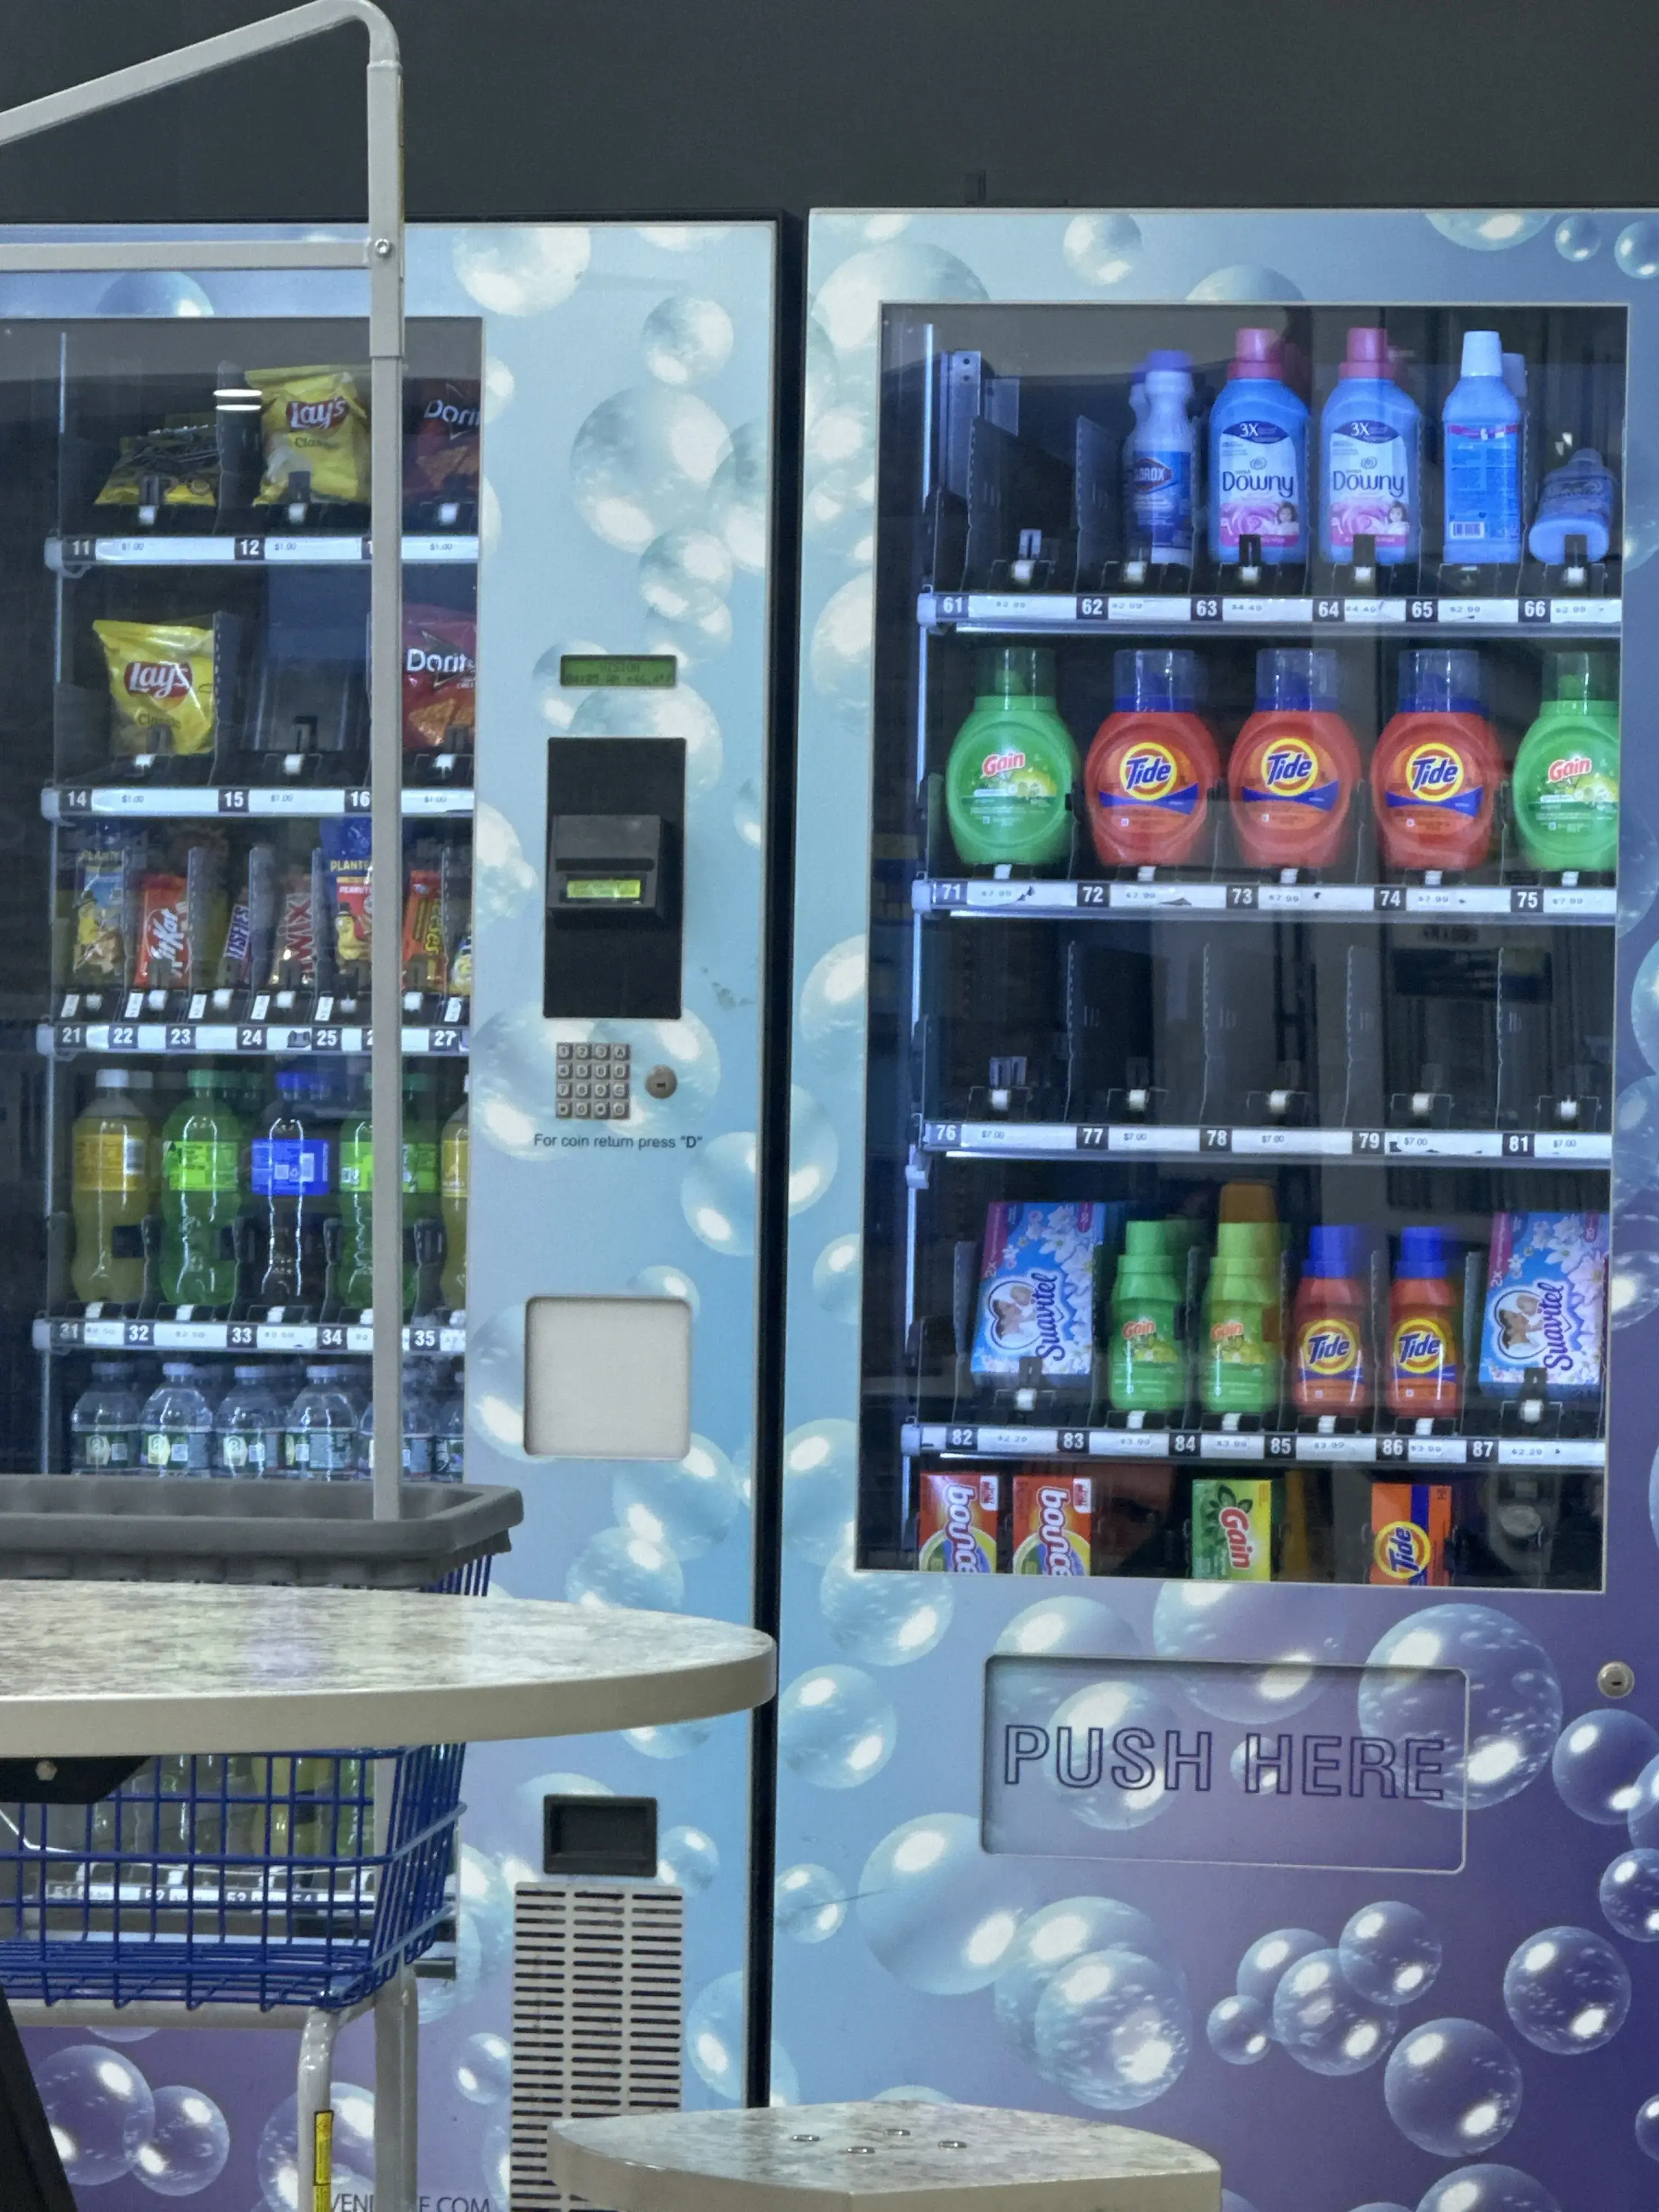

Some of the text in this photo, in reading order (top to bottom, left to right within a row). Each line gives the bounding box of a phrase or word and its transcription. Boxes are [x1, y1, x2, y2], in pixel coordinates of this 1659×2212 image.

[290, 397, 346, 429] Lay's
[424, 399, 480, 426] Dori
[1239, 422, 1259, 437] 3X
[1351, 422, 1370, 437] 3X
[1133, 467, 1165, 482] LOROX
[1222, 471, 1294, 498] Downy
[1333, 470, 1405, 498] Downy
[72, 539, 90, 556] 11
[240, 539, 259, 555] 12
[943, 596, 962, 613] 61
[1082, 598, 1103, 615] 62
[1196, 600, 1218, 617] 63
[1318, 601, 1339, 618] 64
[1412, 601, 1432, 618] 65
[1525, 600, 1545, 617] 66
[407, 648, 475, 673] Dorit
[983, 753, 1026, 777] Gain
[1125, 756, 1172, 790] Tide
[1267, 753, 1313, 786] Tide
[1548, 758, 1592, 783] Gain
[1412, 758, 1459, 791] Tide
[67, 790, 87, 806] 14
[224, 791, 244, 808] 15
[351, 791, 371, 807] 16
[330, 859, 371, 872] PLANTE
[943, 884, 961, 900] 71
[1082, 887, 1103, 903] 72
[1232, 888, 1252, 905] 73
[1380, 890, 1401, 907] 74
[1517, 891, 1538, 909] 75
[63, 1028, 81, 1043] 21
[114, 1027, 133, 1043] 22
[171, 1028, 191, 1045] 23
[242, 1029, 262, 1046] 24
[317, 1030, 337, 1046] 25
[434, 1030, 457, 1046] 27
[936, 1124, 957, 1141] 76
[1082, 1128, 1104, 1144] 77
[1206, 1130, 1227, 1147] 78
[1359, 1133, 1380, 1149] 79
[534, 1133, 557, 1147] For
[561, 1135, 588, 1147] coin
[594, 1135, 634, 1148] return
[638, 1137, 676, 1150] press
[1509, 1136, 1529, 1152] 81
[1030, 1272, 1066, 1362] Suavitel
[59, 1323, 78, 1339] 31
[129, 1325, 149, 1341] 32
[232, 1327, 252, 1343] 33
[1122, 1320, 1156, 1339] Gain
[1210, 1323, 1244, 1341] Gain
[1537, 1282, 1574, 1371] Suavitel
[323, 1329, 342, 1345] 34
[415, 1329, 435, 1346] 35
[1308, 1334, 1350, 1364] Tide
[1399, 1333, 1441, 1364] Tide
[952, 1429, 973, 1446] 82
[1063, 1432, 1085, 1449] 83
[1175, 1435, 1196, 1452] 84
[1271, 1437, 1292, 1454] 85
[1381, 1439, 1403, 1455] 86
[1472, 1441, 1494, 1457] 87
[946, 1485, 979, 1572] bounce
[1040, 1487, 1073, 1576] bounce
[1219, 1506, 1254, 1570] Gain
[1389, 1526, 1420, 1572] Tide
[1004, 1724, 1445, 1802] PUSH HERE
